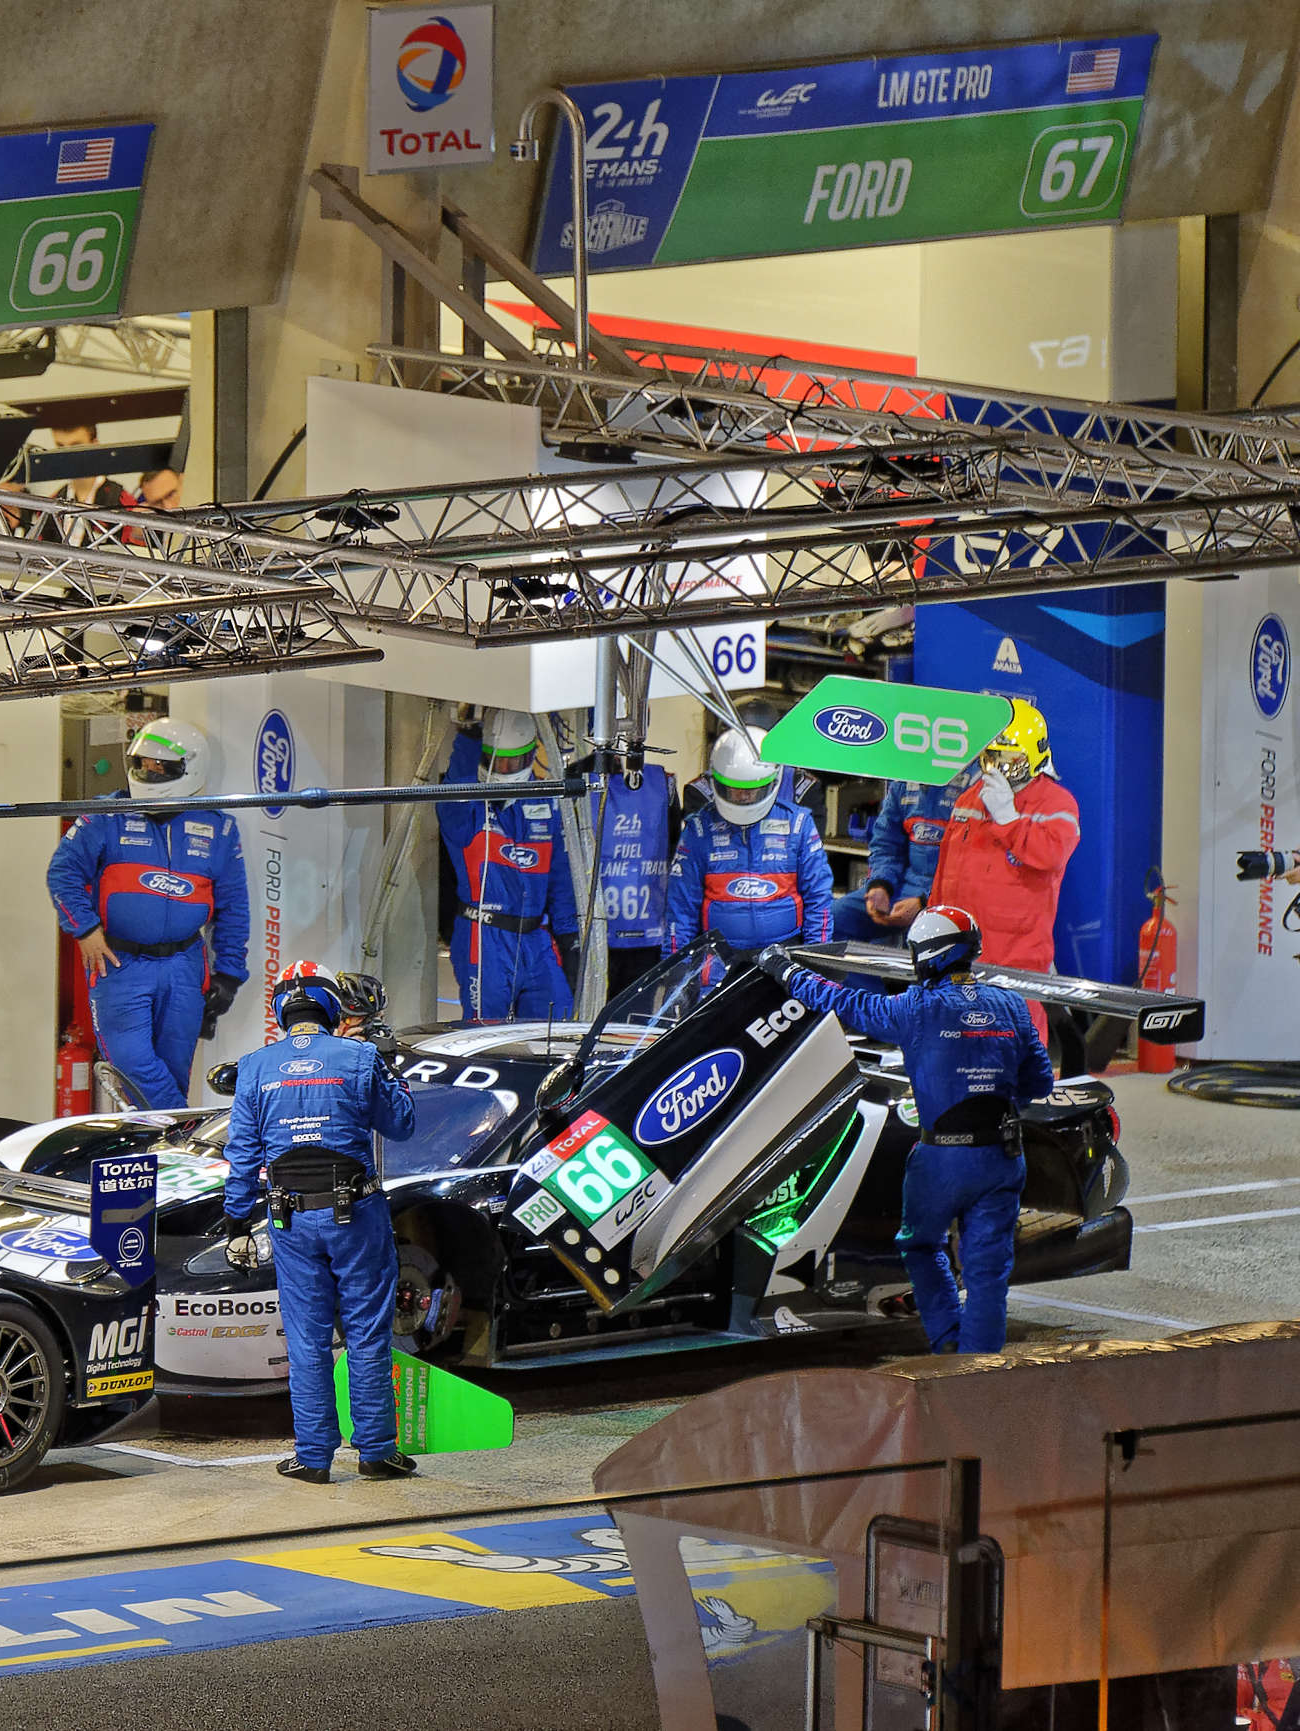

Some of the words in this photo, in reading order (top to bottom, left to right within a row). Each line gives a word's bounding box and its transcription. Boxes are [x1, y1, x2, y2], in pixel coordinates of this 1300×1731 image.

[877, 73, 908, 109] LM
[913, 67, 951, 105] GTE
[953, 64, 993, 100] PRO
[381, 128, 481, 156] TOTAL
[599, 159, 659, 179] MANS
[1039, 134, 1114, 202] 67
[804, 158, 912, 224] FORD
[28, 227, 106, 296] 66
[712, 633, 757, 676] 66
[1257, 634, 1285, 700] Ford
[828, 709, 874, 741] Ford
[894, 712, 969, 757] 66
[1260, 748, 1276, 800] FORD
[613, 843, 642, 859] FUEL
[266, 848, 281, 902] FORD
[600, 861, 629, 877] LANE
[149, 874, 185, 896] Ford
[734, 880, 768, 898] Ford
[604, 885, 650, 920] 862
[988, 975, 1072, 997] Powered
[1073, 985, 1100, 1000] by
[966, 1013, 987, 1025] Ford
[940, 1031, 961, 1039] FORD
[287, 1060, 315, 1073] Ford
[395, 1055, 499, 1089] RD
[261, 1081, 281, 1092] FORD
[657, 1064, 728, 1133] Ford
[292, 1133, 322, 1143] sparco
[553, 1119, 600, 1152] TOTAL
[99, 1162, 154, 1177] TOTAL
[556, 1136, 642, 1214] 66
[99, 1176, 153, 1193] 道达尔
[520, 1195, 558, 1230] PRO
[14, 1228, 82, 1257] Ford
[175, 1299, 281, 1316] EcoBoos
[176, 1327, 208, 1337] Castrol
[211, 1325, 269, 1338] EDGE
[86, 1361, 106, 1374] Digital
[107, 1357, 142, 1371] Technology
[100, 1375, 152, 1392] DUNLOP
[405, 1367, 414, 1420] ENGINE
[405, 1423, 413, 1445] ON
[418, 1404, 427, 1450] RESET
